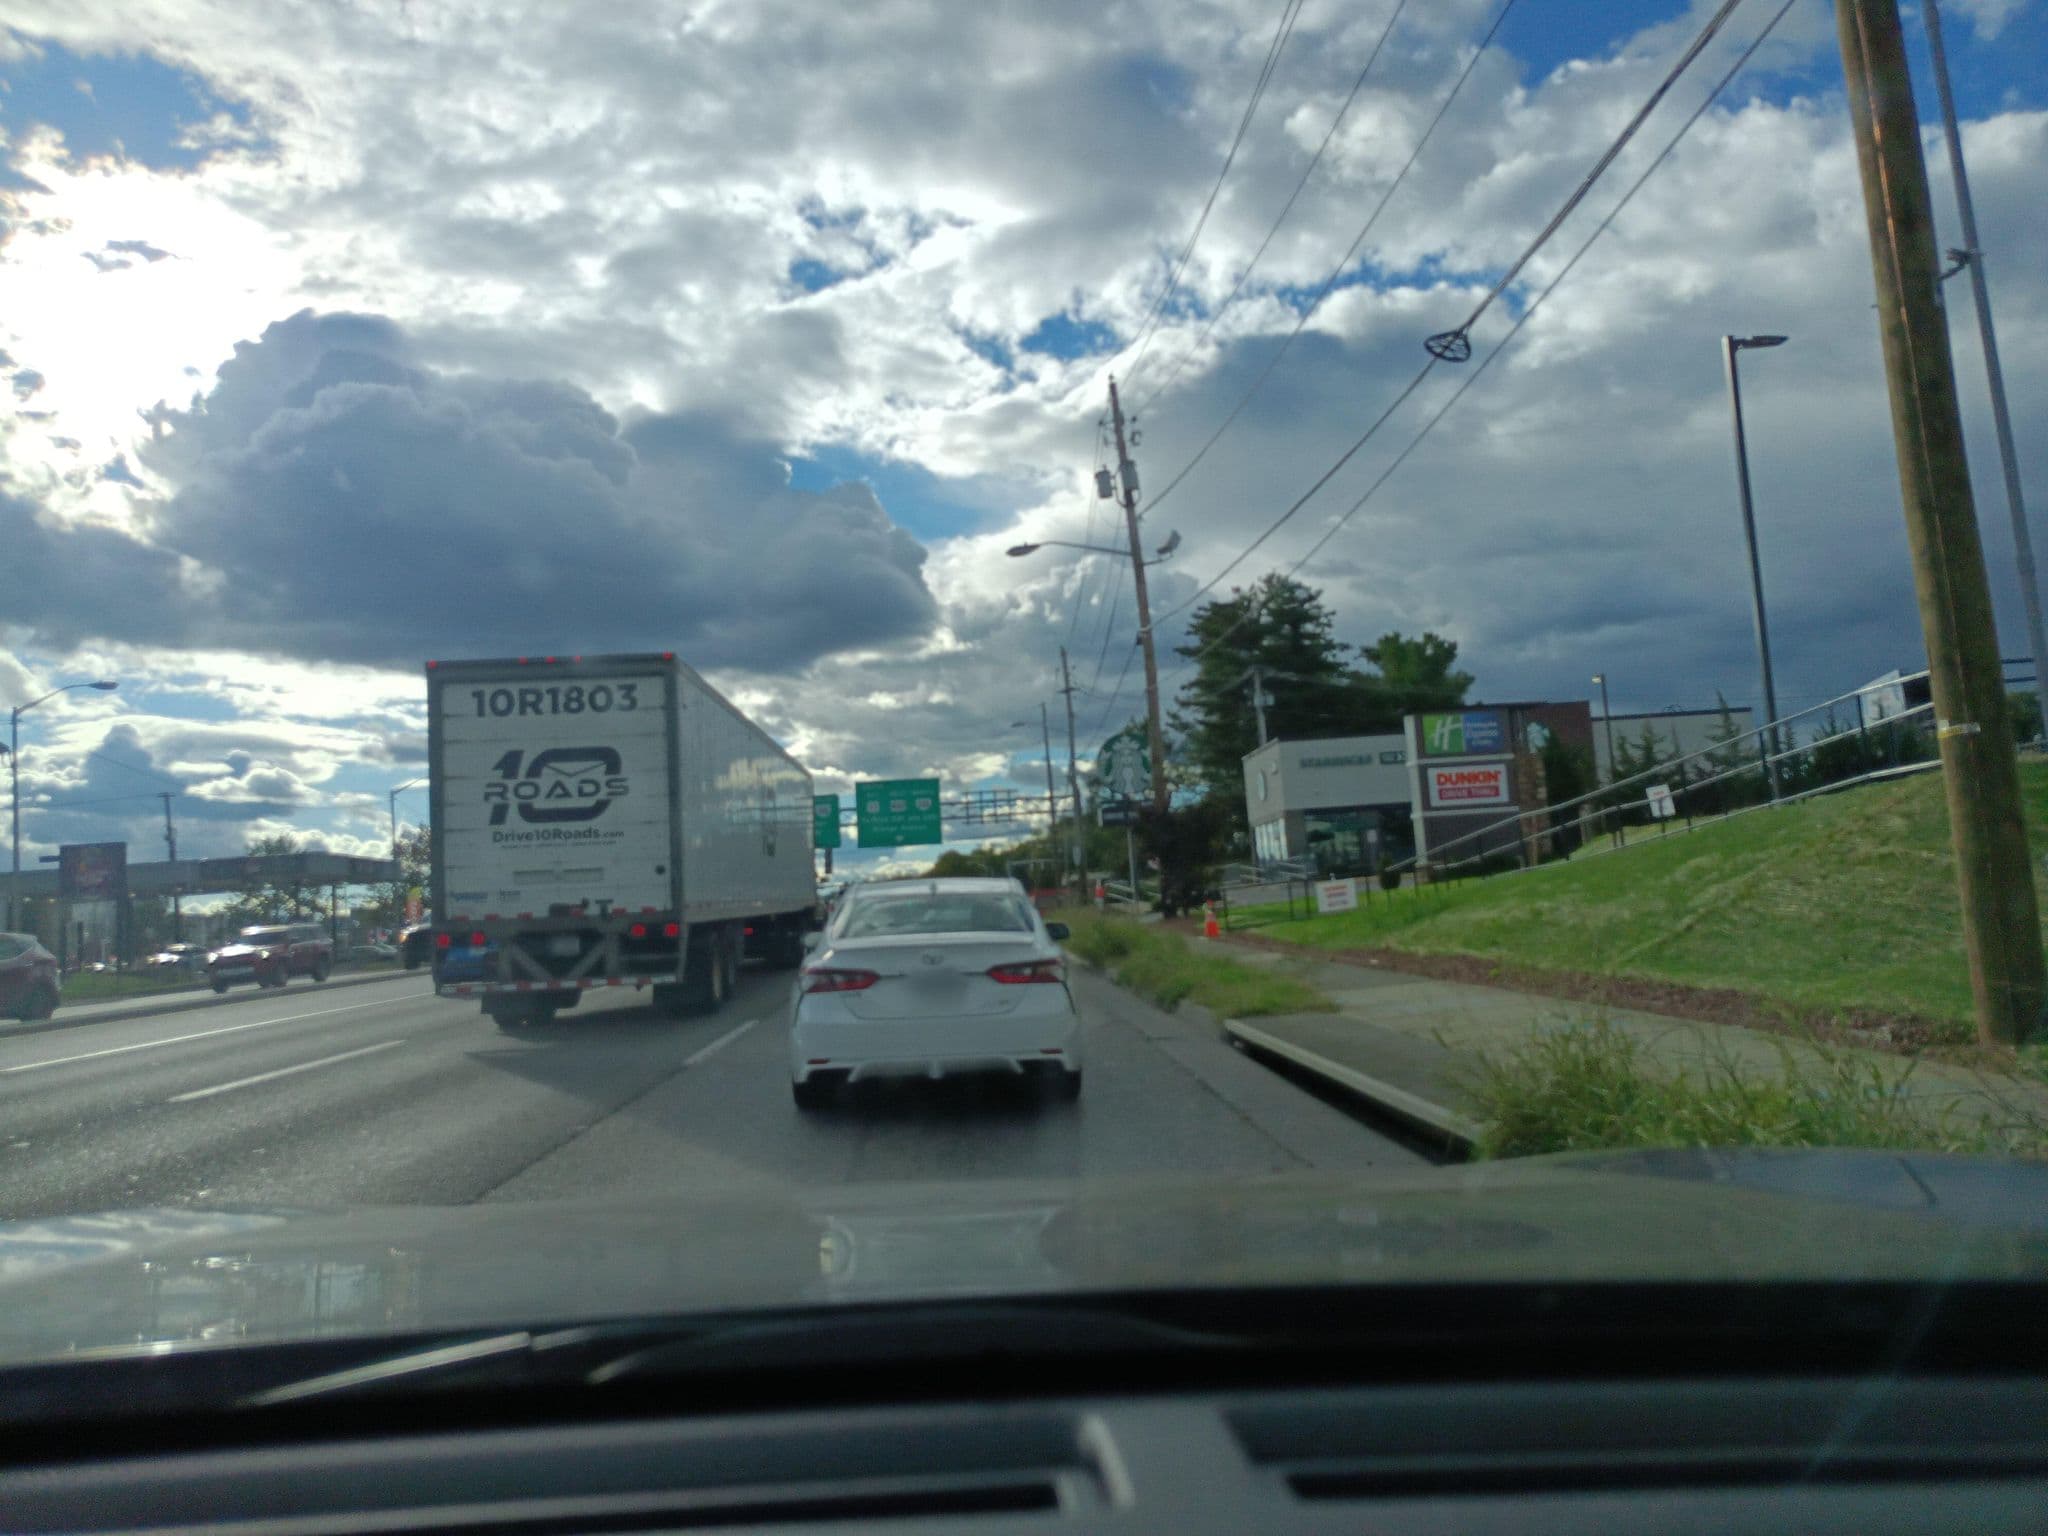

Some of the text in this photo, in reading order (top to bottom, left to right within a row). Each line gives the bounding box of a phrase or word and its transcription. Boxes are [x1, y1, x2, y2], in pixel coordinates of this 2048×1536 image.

[472, 683, 638, 718] 10R1803
[484, 777, 630, 802] ROADS
[493, 826, 625, 843] Drive10Roads.com
